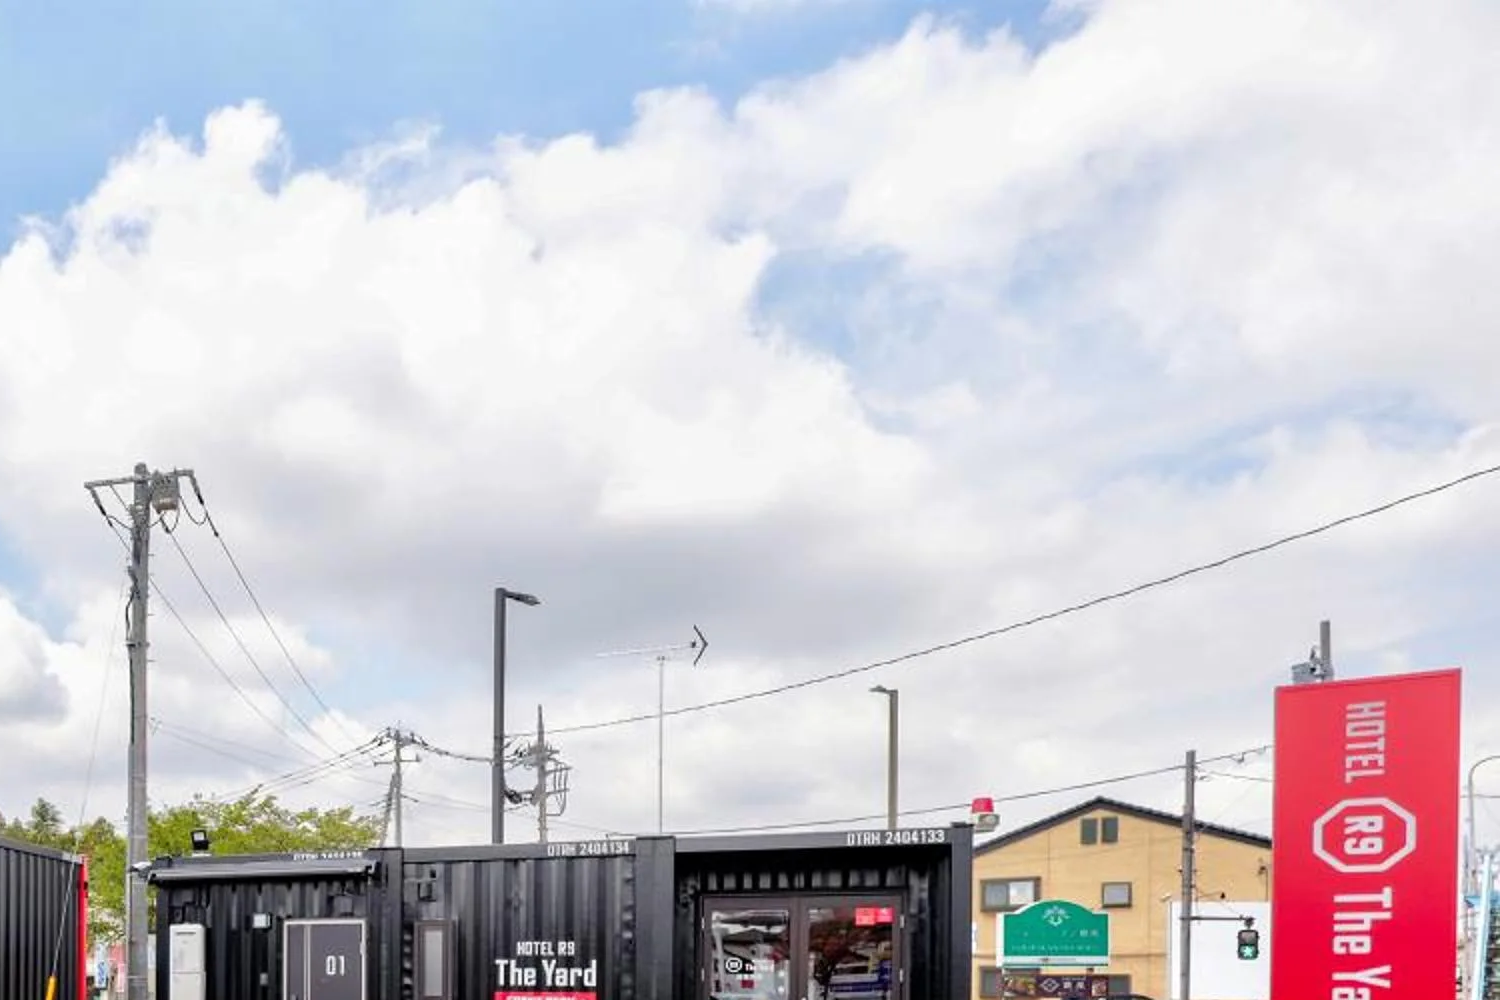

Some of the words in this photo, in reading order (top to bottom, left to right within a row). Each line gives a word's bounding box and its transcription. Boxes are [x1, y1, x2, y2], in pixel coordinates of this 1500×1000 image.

[1345, 700, 1386, 784] HOTEL
[885, 829, 945, 845] 2404133
[1344, 815, 1384, 855] R9
[1333, 886, 1393, 955] The
[516, 941, 555, 956] HOTEL
[557, 941, 575, 956] R9
[325, 955, 345, 976] 01
[495, 959, 537, 987] The
[541, 959, 597, 987] Yard
